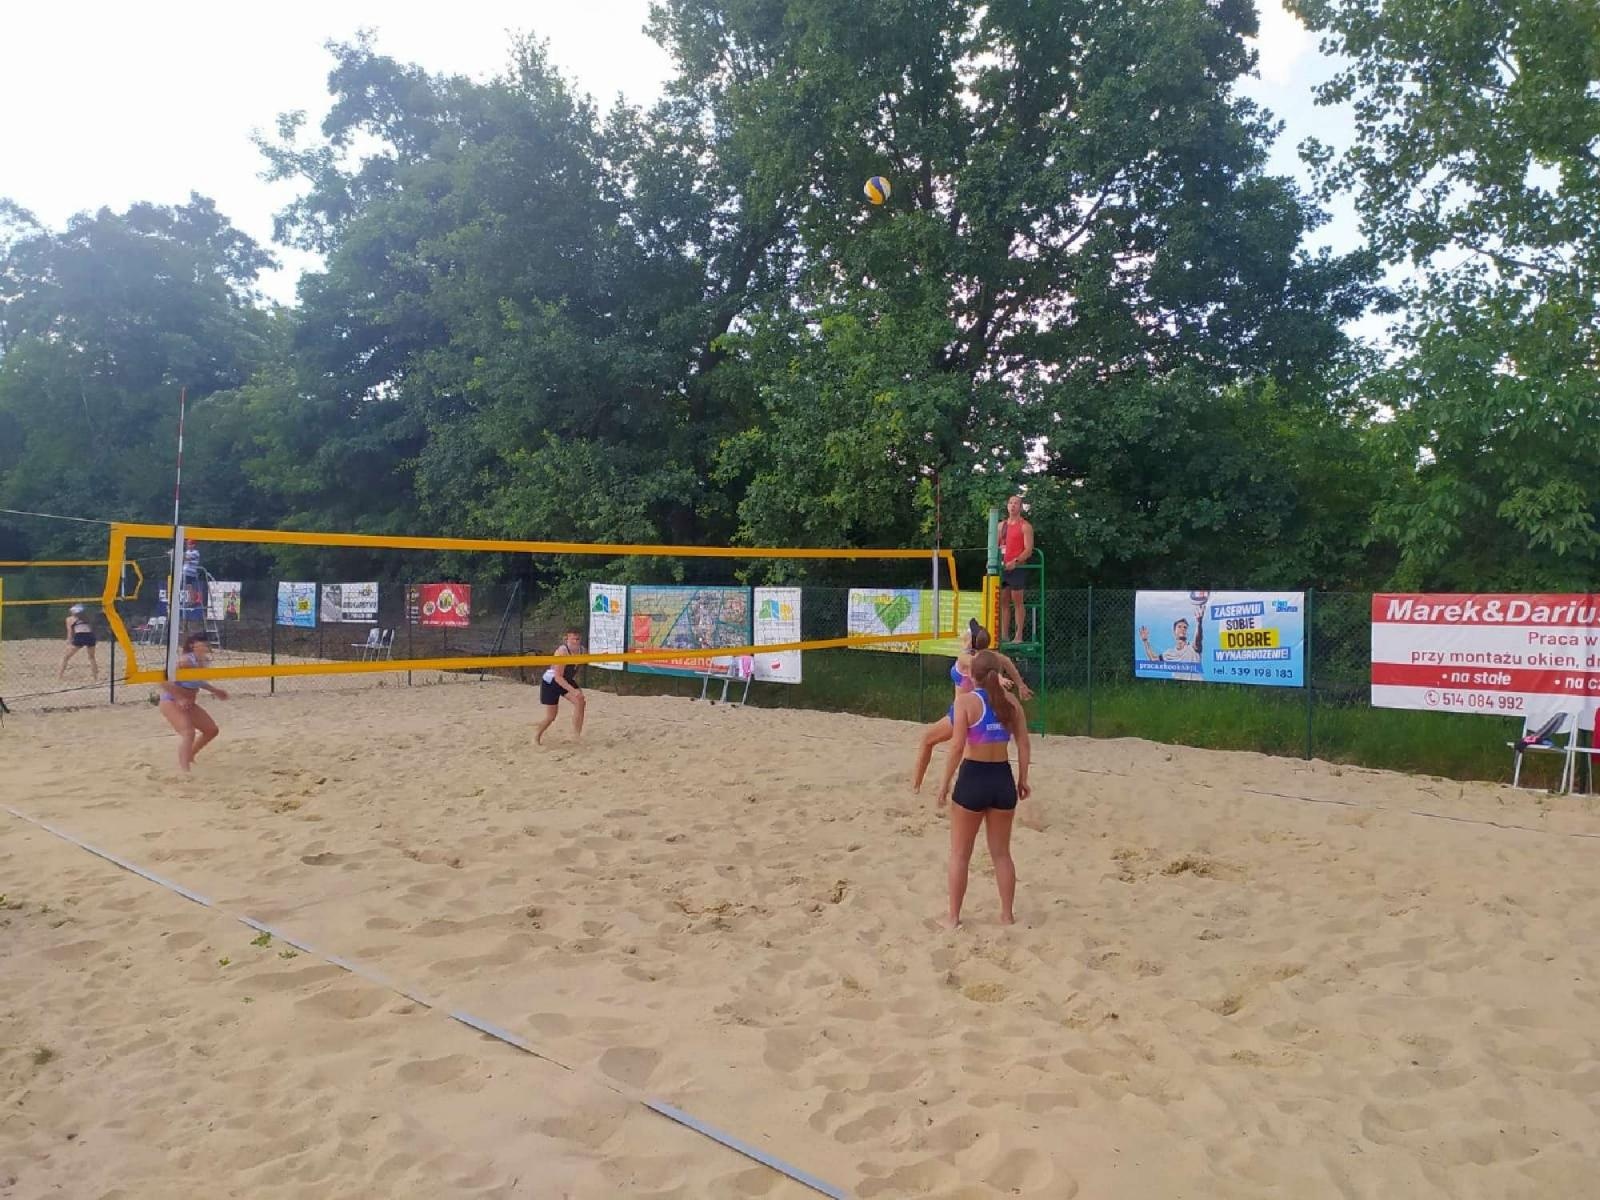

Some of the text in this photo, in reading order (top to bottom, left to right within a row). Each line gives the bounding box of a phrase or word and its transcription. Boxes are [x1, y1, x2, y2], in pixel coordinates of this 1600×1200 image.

[1214, 603, 1262, 618] ZASERWUJ
[1386, 599, 1600, 624] Marek&Dariu
[1226, 617, 1255, 631] SOBIE
[1227, 631, 1271, 648] DOBRE
[1528, 631, 1598, 646] Praca w
[1411, 651, 1445, 664] przy
[1449, 651, 1522, 666] montażu
[1527, 653, 1580, 668] okien,
[1213, 665, 1293, 679] tel. 539 198 183
[1451, 672, 1470, 683] na
[1474, 672, 1512, 685] stałe
[1564, 677, 1585, 690] na
[1442, 693, 1524, 710] 514 084 992
